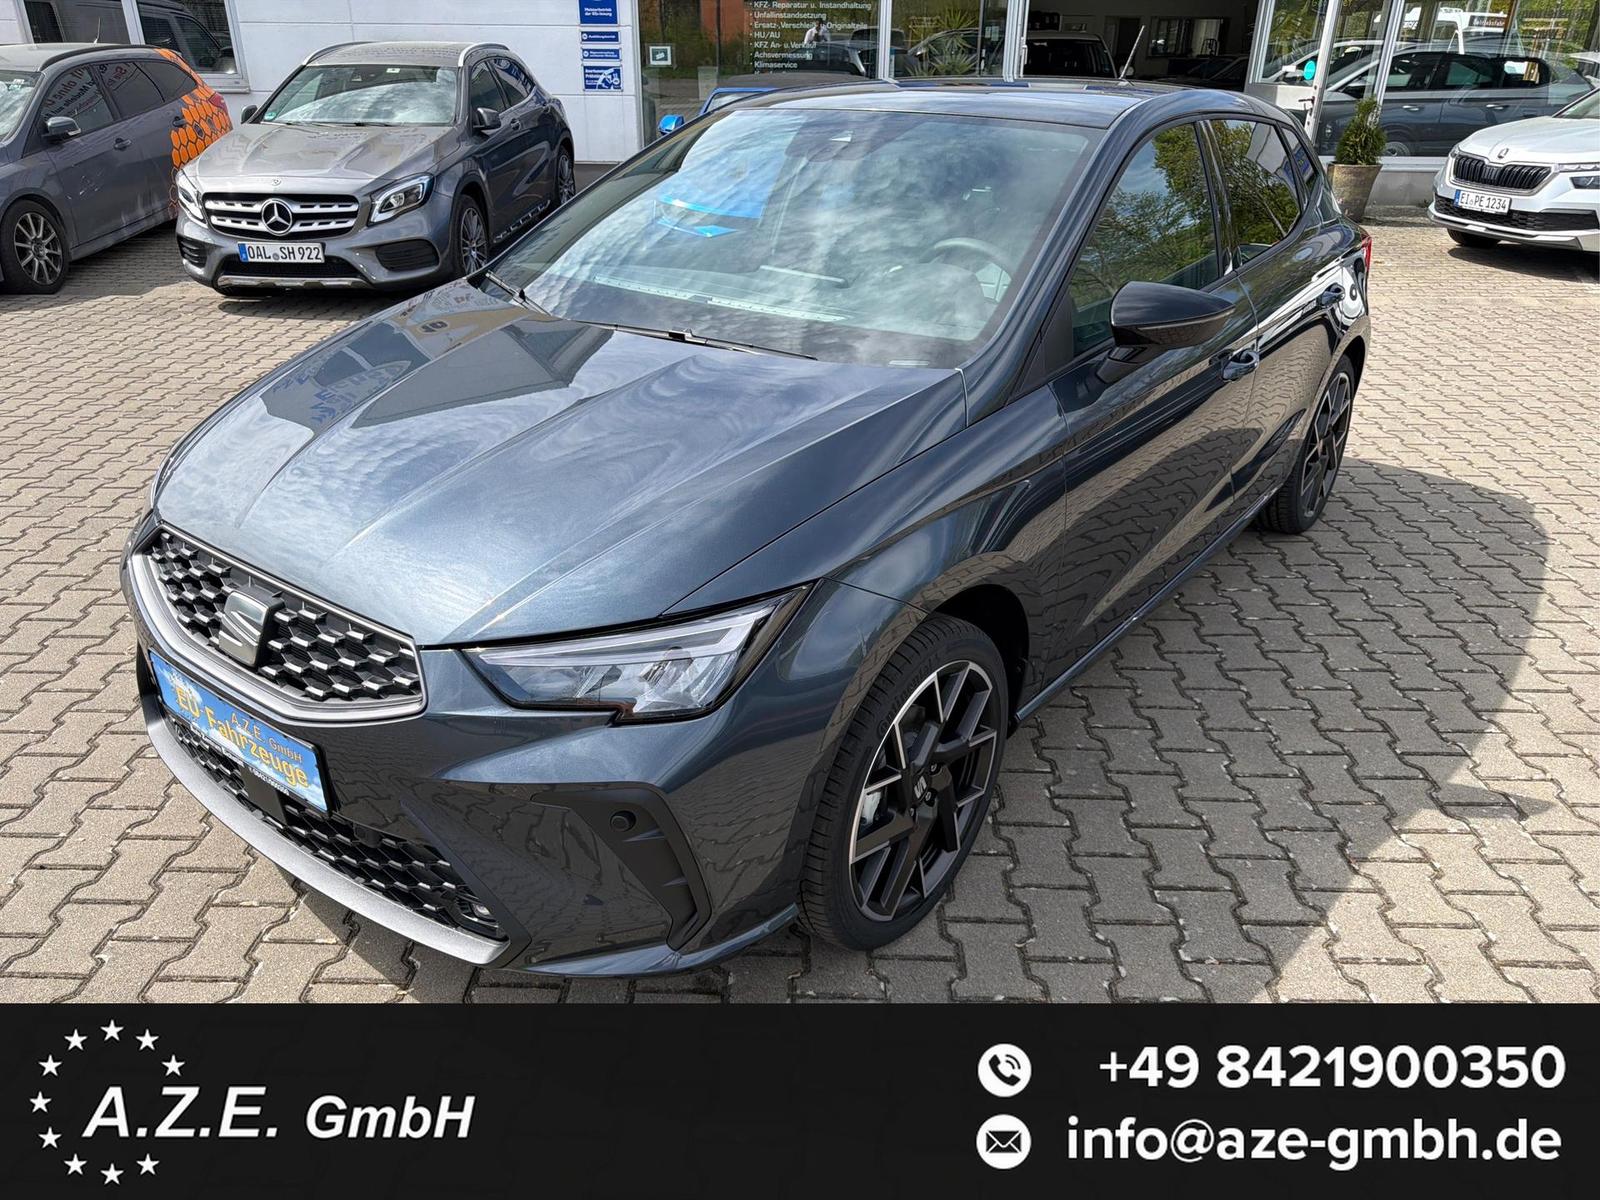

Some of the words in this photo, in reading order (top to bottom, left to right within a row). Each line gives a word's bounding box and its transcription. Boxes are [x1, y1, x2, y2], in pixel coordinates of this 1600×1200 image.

[772, 2, 809, 10] Reparatur
[819, 2, 872, 11] Instandhaltung
[754, 12, 827, 20] Unfallinstandsetzung
[754, 31, 781, 39] HU/AU
[753, 41, 769, 49] KFZ
[754, 52, 813, 60] Achsvermessung
[754, 61, 797, 69] Klimaservice
[1461, 193, 1469, 204] EI
[1475, 194, 1484, 207] PE
[1485, 197, 1506, 210] 1234
[247, 245, 271, 260] OAL
[279, 246, 296, 261] SH
[297, 246, 322, 261] 922
[268, 737, 303, 763] GmbH
